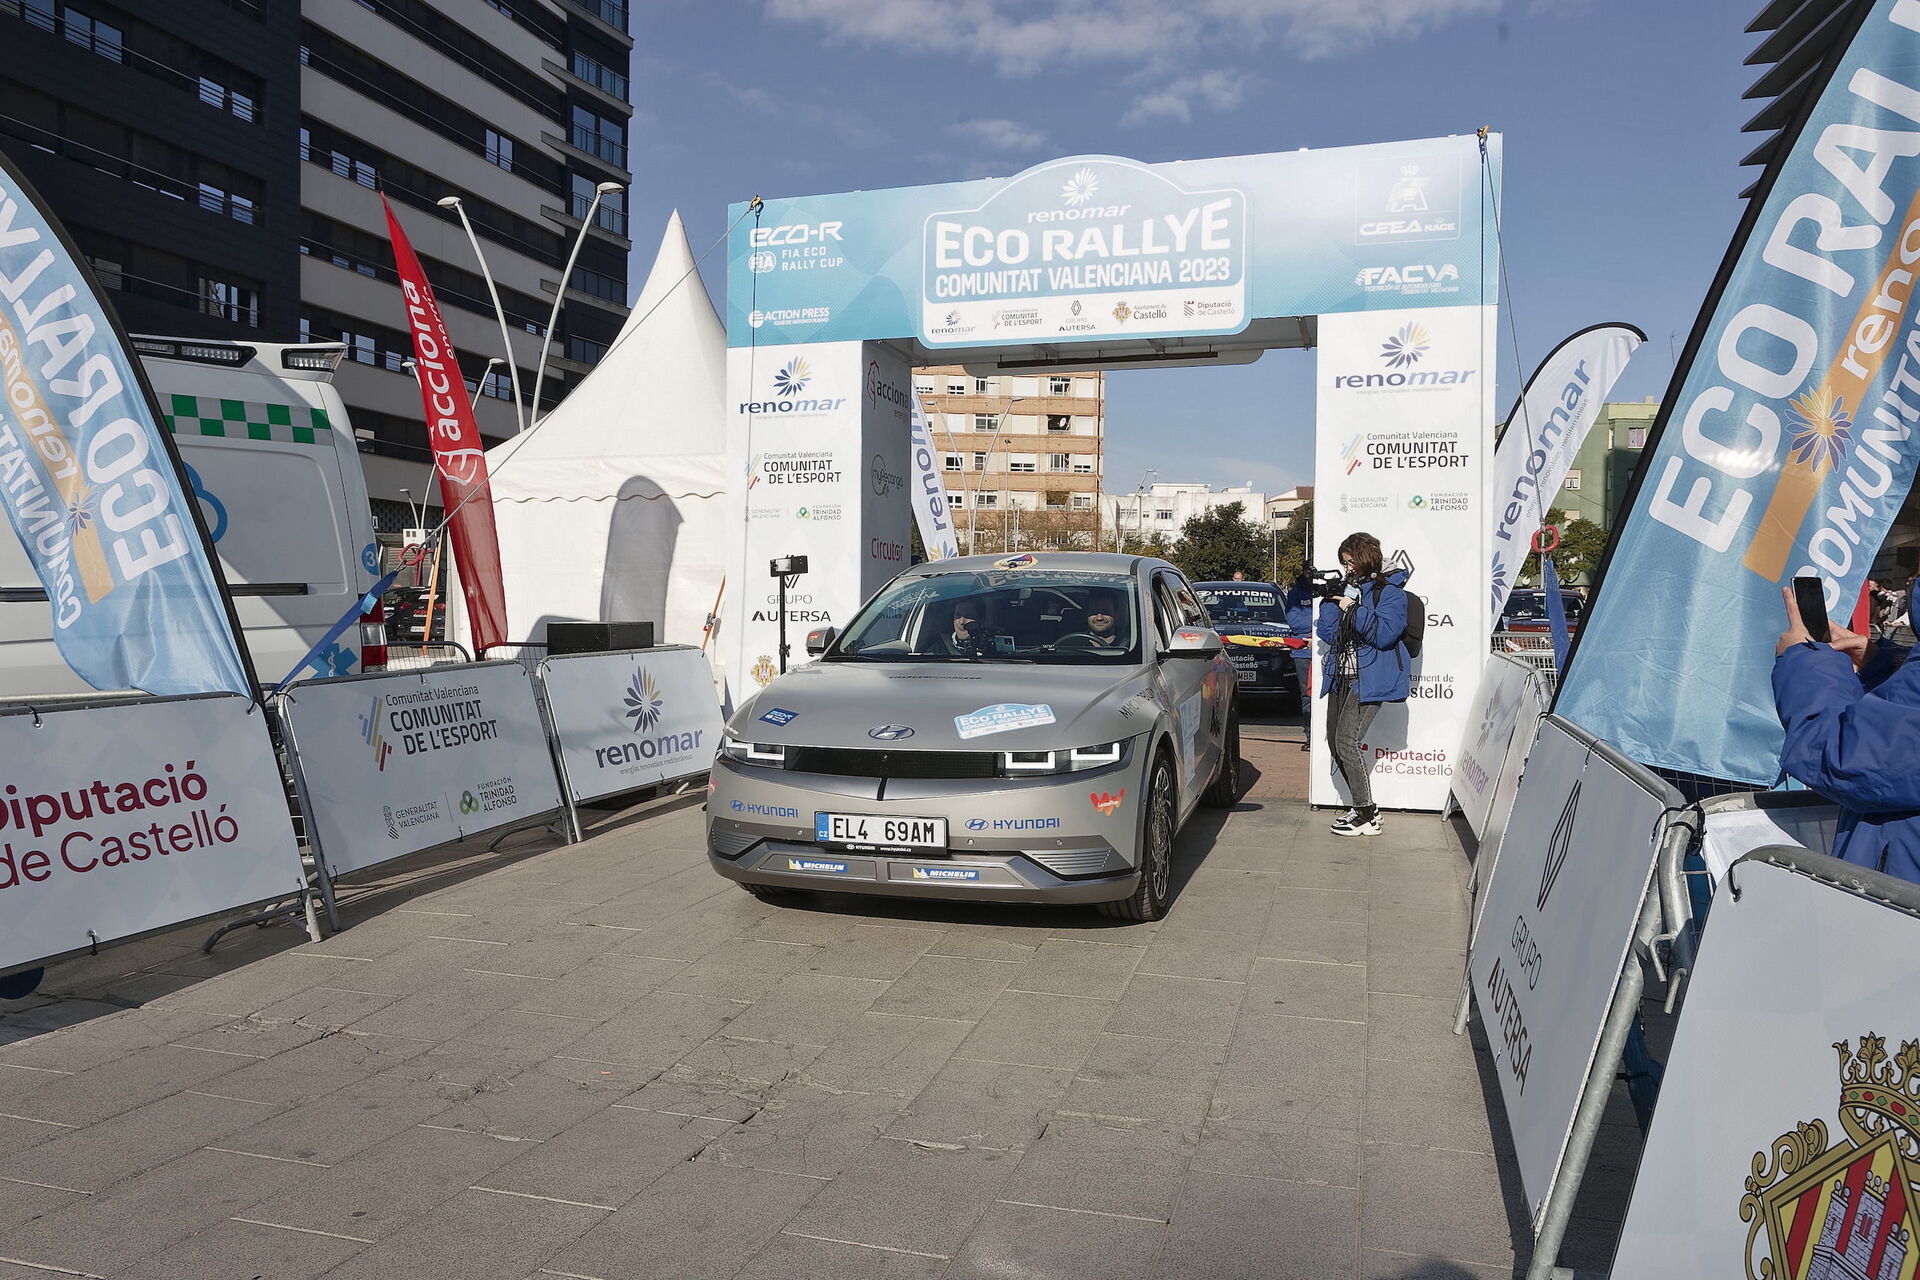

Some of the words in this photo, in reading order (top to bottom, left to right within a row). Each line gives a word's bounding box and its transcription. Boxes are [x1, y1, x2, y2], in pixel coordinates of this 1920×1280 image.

[1027, 203, 1131, 224] renomar
[936, 221, 1030, 268] ECO
[1042, 198, 1232, 262] RALLYE
[782, 249, 800, 259] FIA
[804, 246, 826, 257] ECO
[782, 260, 816, 271] RALLY
[820, 257, 843, 268] CUP
[935, 268, 1042, 298] COMUNITAT
[1048, 261, 1173, 292] VALENCIANA
[1179, 257, 1231, 282] 2023
[1197, 300, 1232, 309] Diputació
[764, 308, 801, 321] ACTION
[802, 307, 830, 318] PRESS
[1002, 313, 1038, 321] COMUNITAT
[1133, 309, 1167, 320] Castelló
[931, 326, 976, 335] renomar
[402, 279, 462, 442] acciona
[1336, 369, 1476, 388] renomar
[877, 380, 909, 409] acciona
[739, 398, 846, 414] renomar
[1367, 432, 1410, 441] Comunitat
[1412, 431, 1458, 440] Valenciana
[1649, 303, 1818, 553] ECO
[764, 452, 797, 460] Comunitat
[799, 451, 833, 459] Valenciana
[1367, 441, 1458, 455] COMUNITAT
[1497, 359, 1591, 541] renomar
[764, 460, 832, 472] COMUNITAT
[1373, 457, 1392, 469] DE
[1397, 455, 1469, 468] L'ESPORT
[769, 473, 783, 484] DE
[787, 472, 842, 483] L'ESPORT
[1215, 590, 1272, 598] HYUNDAI
[1443, 673, 1454, 682] de
[386, 689, 433, 706] Comunitat
[434, 684, 479, 701] Valenciana
[1410, 683, 1454, 699] stelló
[390, 700, 482, 732] COMUNITAT
[960, 716, 987, 726] ECO
[993, 705, 1047, 720] RALLYE
[403, 732, 428, 755] DE
[432, 720, 498, 750] L'ESPORT
[595, 729, 703, 768] renomar
[1375, 745, 1446, 763] Diputació
[1375, 763, 1392, 774] de
[1395, 761, 1453, 776] Castelló
[479, 785, 515, 802] TRINIDAD
[395, 801, 438, 819] GENERALITAT
[483, 795, 517, 813] ALFONSO
[748, 804, 798, 818] HYUNDAI
[398, 812, 440, 829] VALENCIANA
[993, 818, 1060, 830] HYUNDAI
[61, 804, 238, 872] Castelló
[833, 818, 868, 840] EL4
[885, 821, 935, 843] 69AM
[803, 862, 845, 871] MICHELIN
[929, 869, 976, 878] MICHELIN
[1511, 914, 1542, 991] GRUPO
[1488, 957, 1532, 1096] AUTERSA
